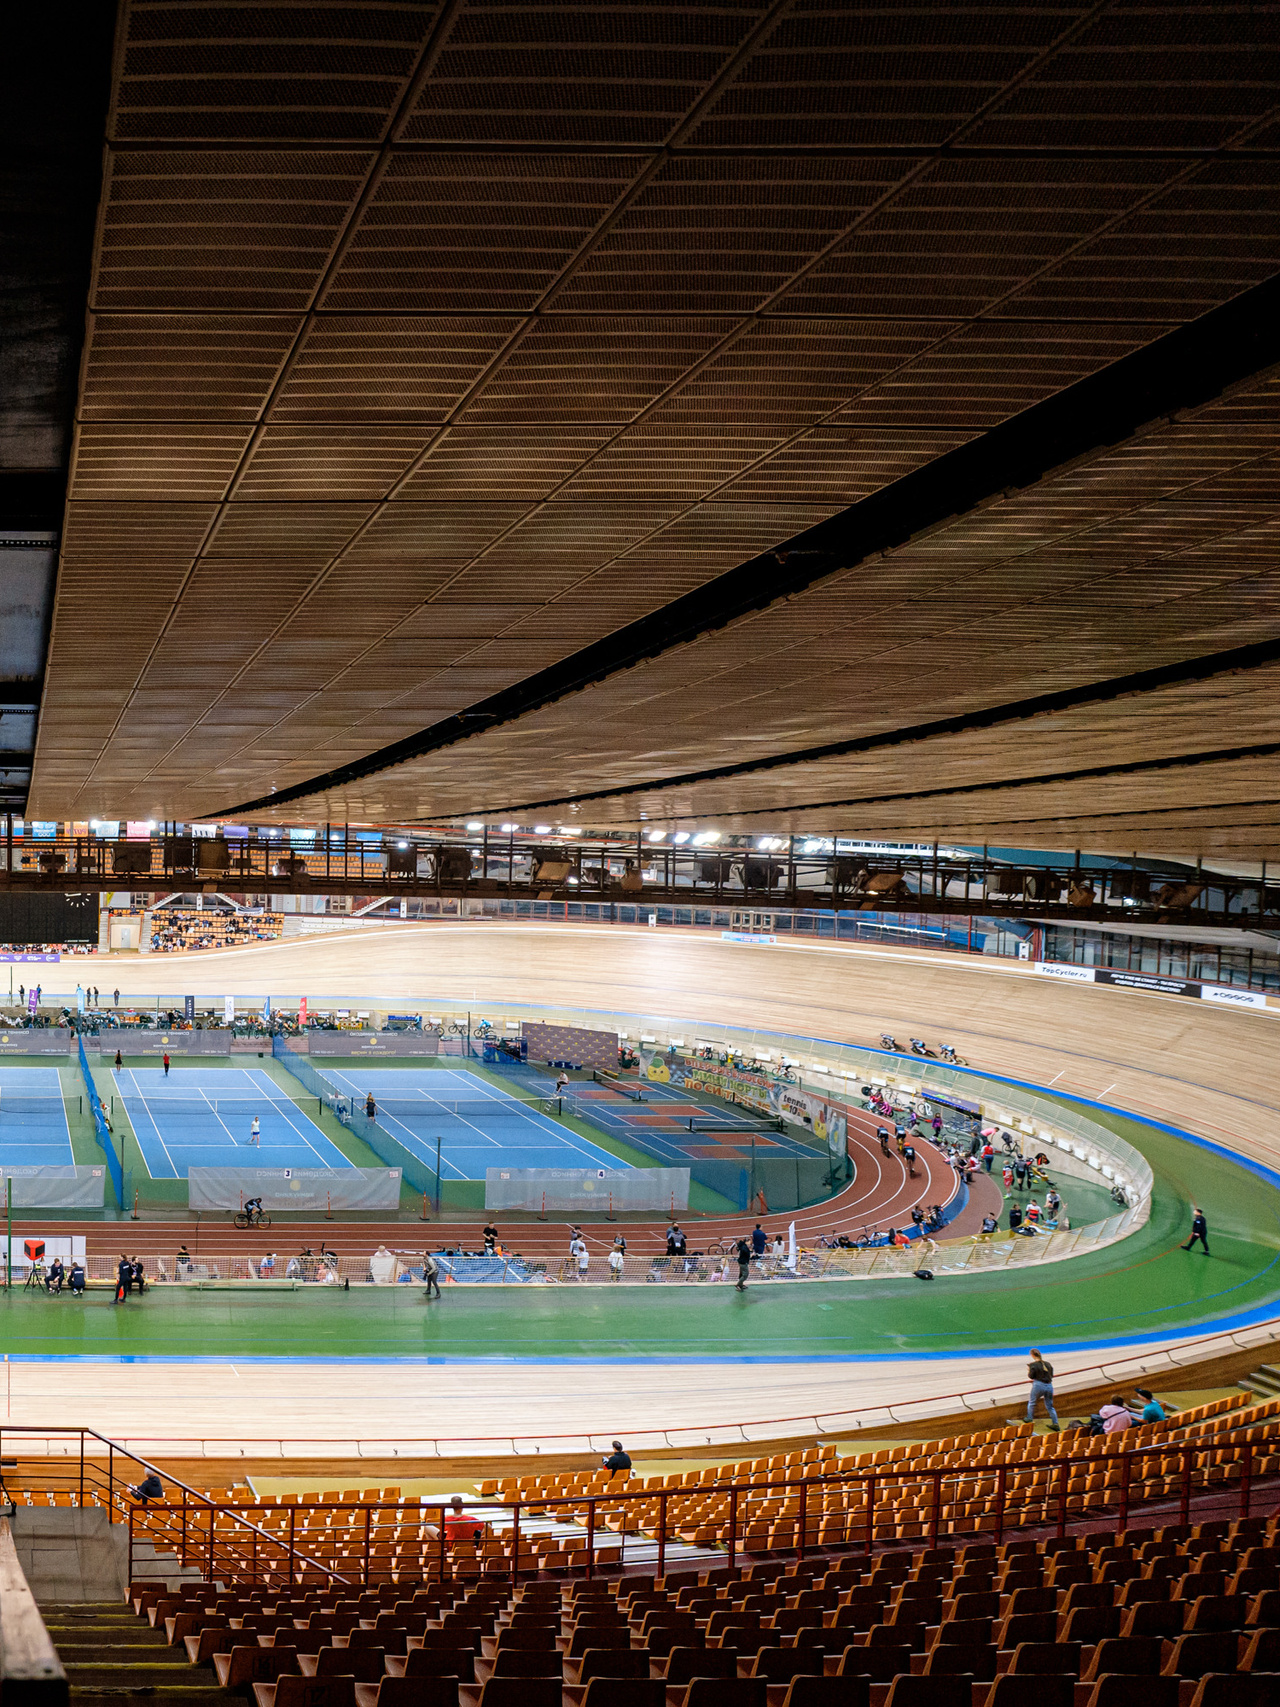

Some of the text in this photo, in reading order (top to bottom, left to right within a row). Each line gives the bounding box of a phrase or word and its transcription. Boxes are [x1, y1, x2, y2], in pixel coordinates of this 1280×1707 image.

[692, 1069, 768, 1099] МИНИ КОРТЫ
[783, 1094, 807, 1110] tennis
